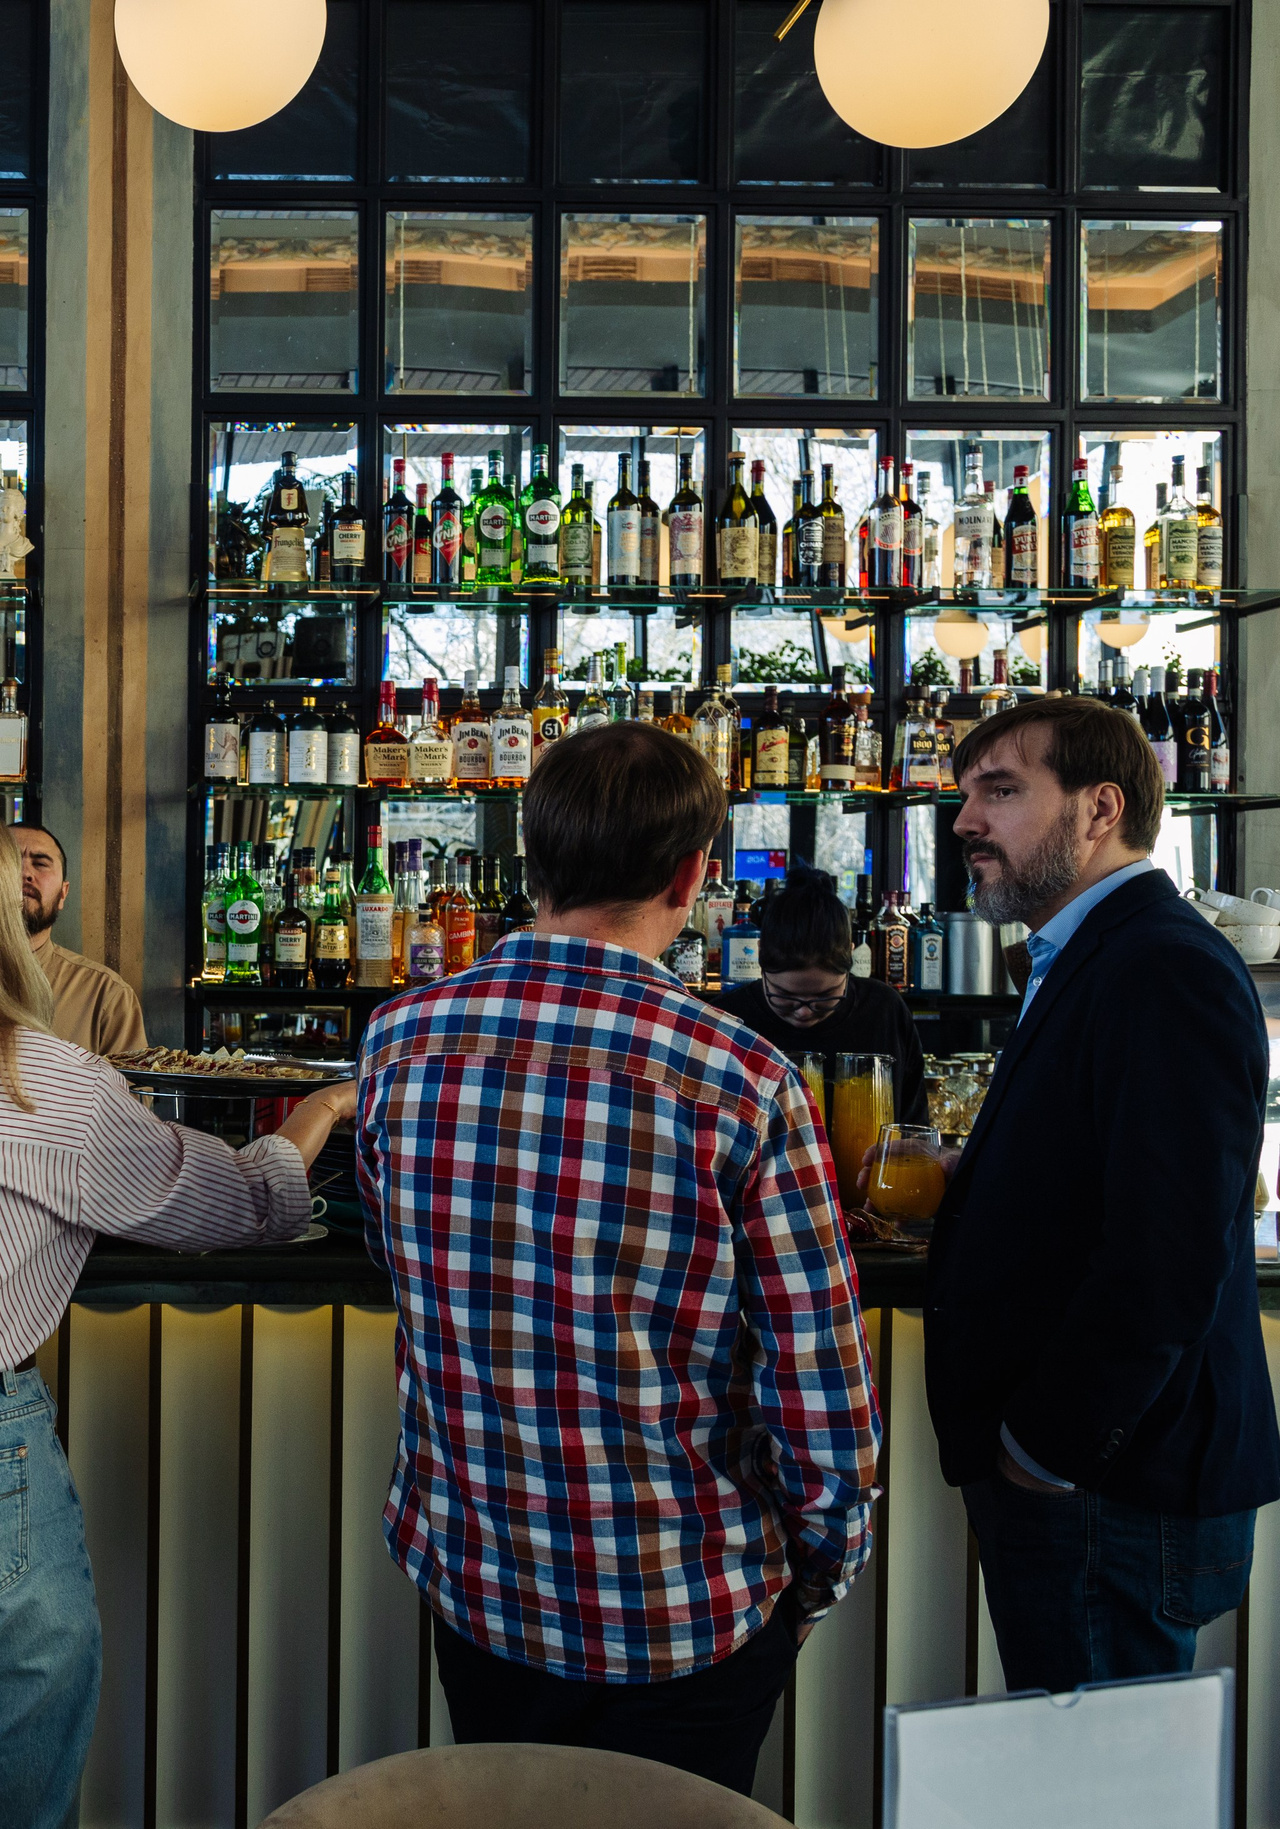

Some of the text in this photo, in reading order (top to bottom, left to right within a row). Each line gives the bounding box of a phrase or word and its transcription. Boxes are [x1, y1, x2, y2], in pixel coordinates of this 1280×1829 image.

[958, 516, 992, 525] MOLINARI
[457, 727, 489, 742] JIM BEAM
[497, 725, 529, 740] JIM BEAM
[544, 722, 559, 736] 51
[912, 740, 932, 749] 1800
[708, 901, 733, 909] BEEFEATER
